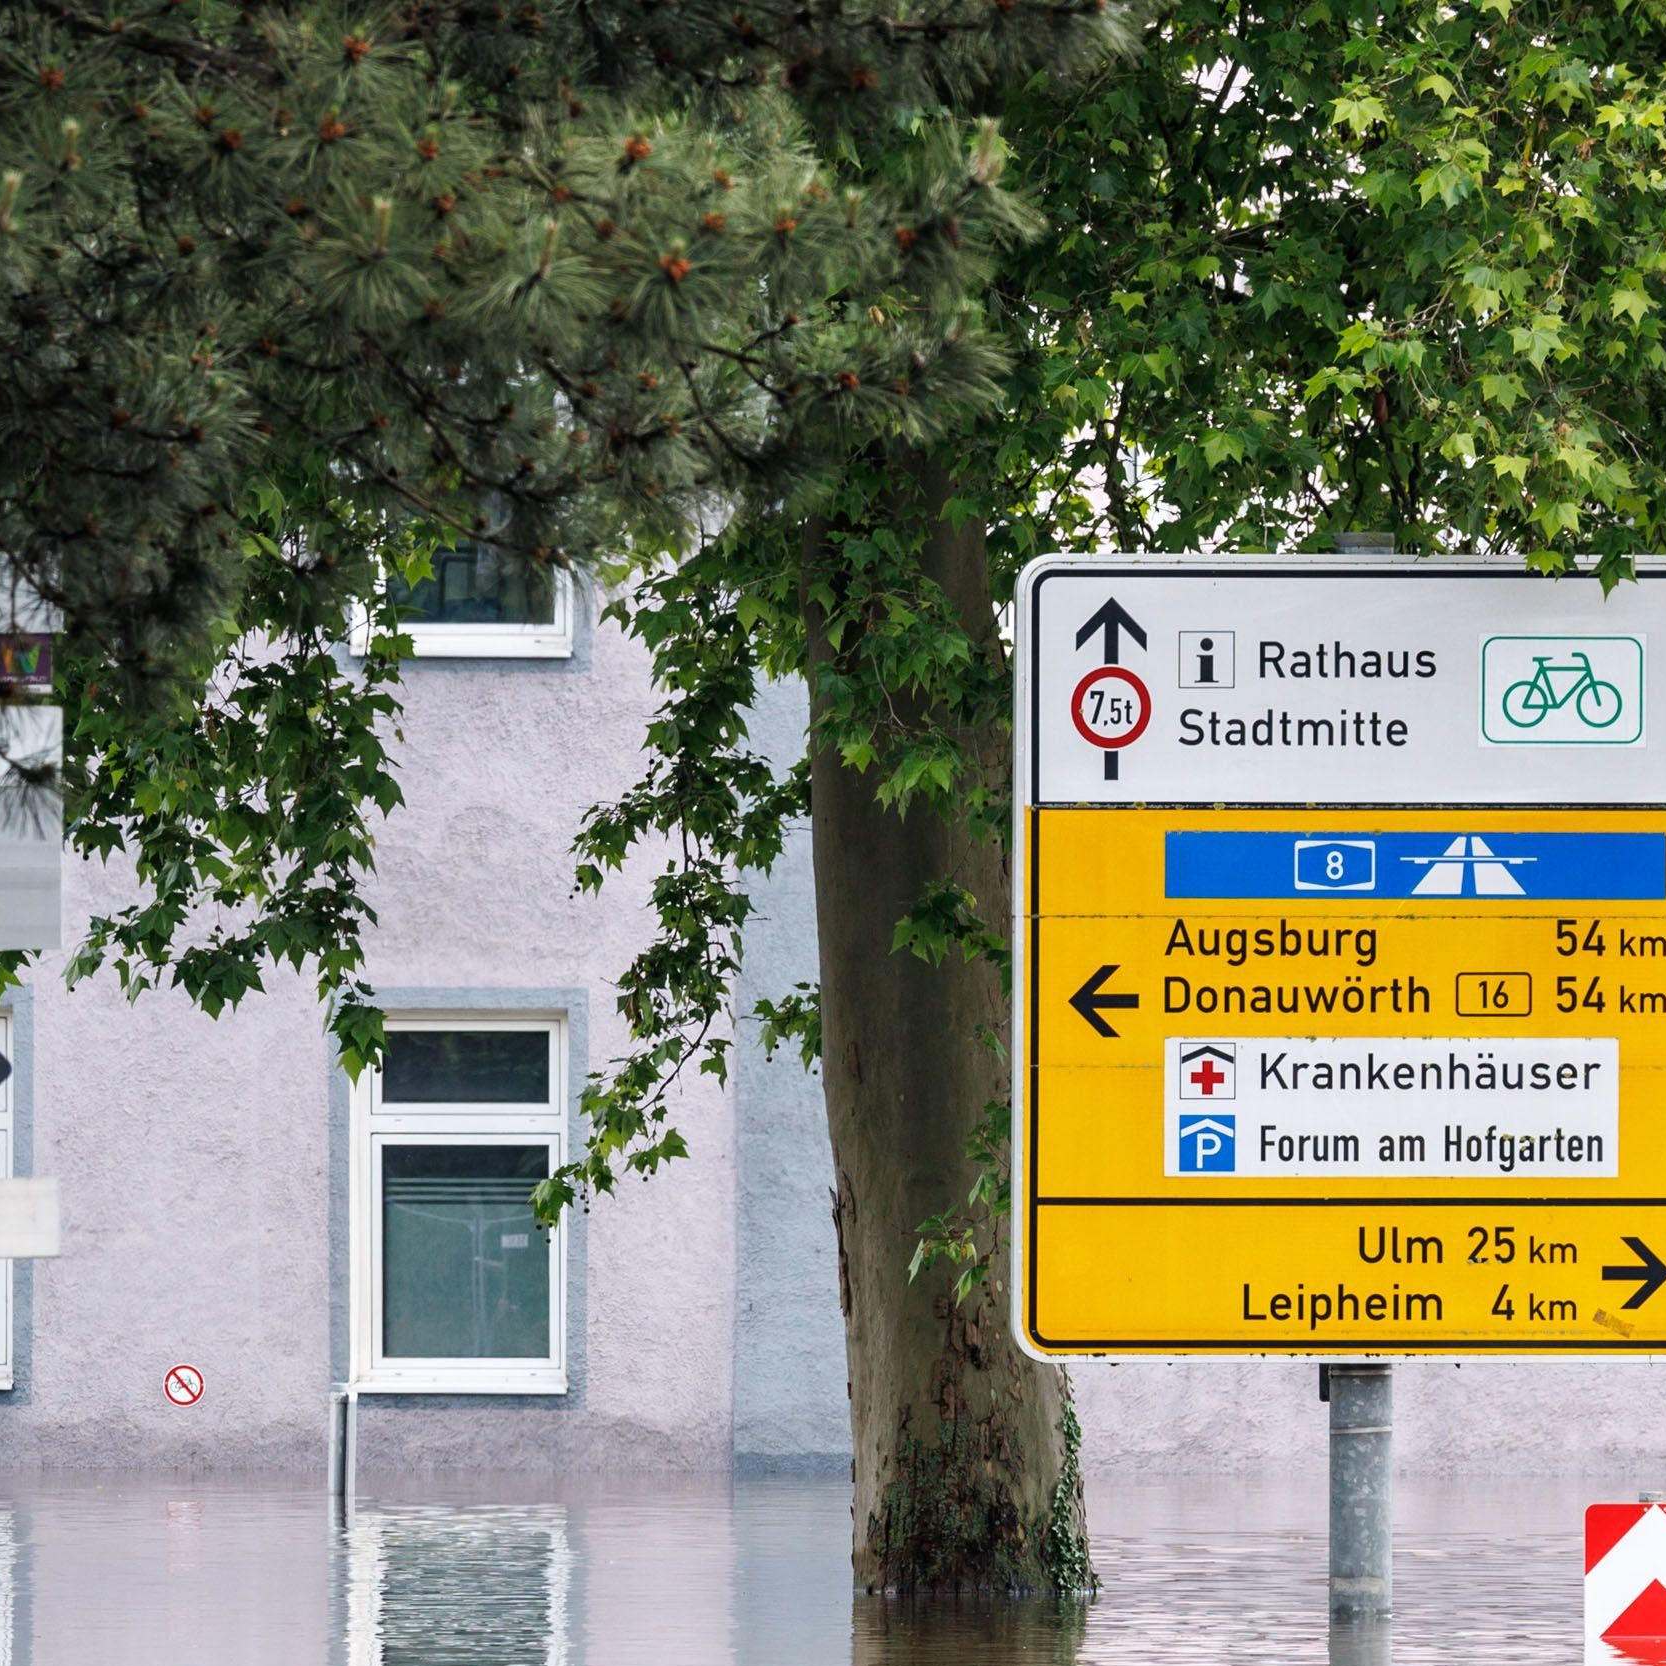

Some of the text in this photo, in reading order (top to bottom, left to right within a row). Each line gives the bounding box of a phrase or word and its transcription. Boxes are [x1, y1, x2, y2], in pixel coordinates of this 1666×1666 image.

[1259, 640, 1437, 678] Rathaus
[1178, 708, 1408, 747] Stadtmitte
[1326, 851, 1343, 879] 8
[1165, 918, 1377, 967] Augsburg
[1556, 919, 1606, 957] 54
[1164, 976, 1430, 1014] Donauwörth
[1479, 981, 1509, 1009] 16
[1556, 976, 1606, 1014] 54
[1260, 1052, 1601, 1090] Krankenhäuser
[1260, 1125, 1359, 1162] Forum
[1379, 1135, 1425, 1162] am
[1444, 1125, 1603, 1173] Hofgarten
[1359, 1226, 1577, 1264] Ulm 25 km
[1243, 1283, 1577, 1330] Leipheim 4 km
